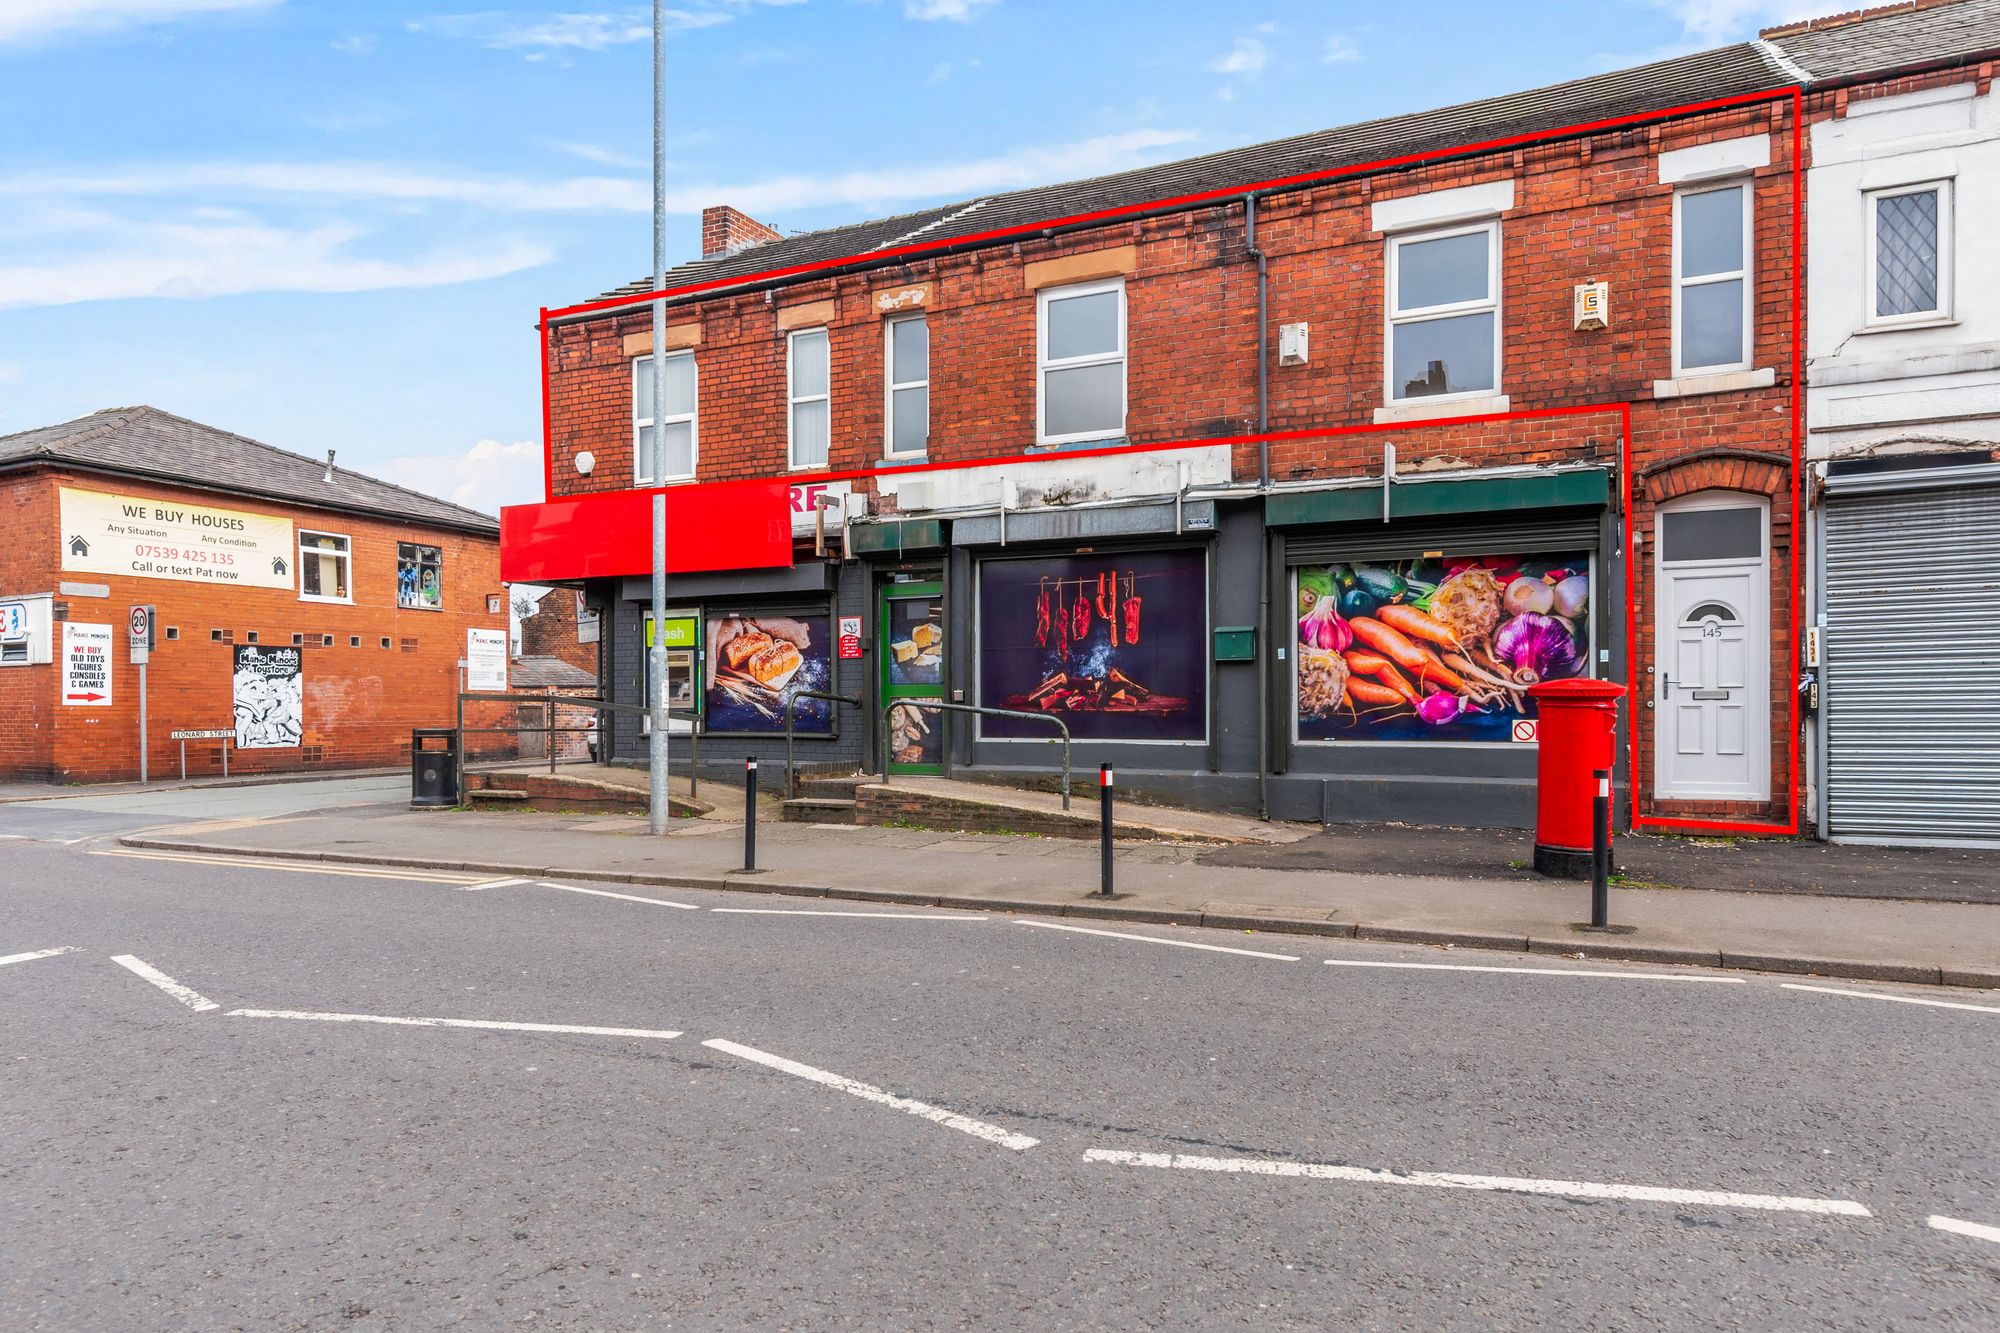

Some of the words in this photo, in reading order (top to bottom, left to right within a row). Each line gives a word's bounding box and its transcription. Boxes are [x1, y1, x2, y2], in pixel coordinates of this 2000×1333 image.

[122, 504, 146, 518] WE
[155, 509, 183, 523] BUY
[192, 513, 245, 531] HOUSES
[107, 524, 125, 535] Any
[127, 526, 168, 538] Situation
[201, 535, 216, 545] Any
[219, 536, 257, 548] Condition
[135, 544, 178, 560] 07539
[182, 549, 207, 563] 425
[211, 552, 234, 565] 135
[132, 561, 153, 573] Call
[156, 565, 168, 574] or
[171, 565, 193, 576] text
[196, 567, 213, 577] Pat
[216, 570, 239, 580] now
[133, 615, 145, 627] 20
[664, 626, 685, 640] ash
[1702, 628, 1722, 637] 145
[132, 637, 146, 645] ZONE
[73, 646, 85, 654] WE
[87, 646, 102, 655] BUY
[70, 654, 84, 662] OLD
[86, 655, 105, 663] TOYS
[240, 653, 267, 665] Manic
[267, 654, 299, 665] Minors
[73, 663, 103, 671] FIGURES
[251, 663, 290, 676] Toystore
[69, 671, 106, 680] CONSOLES
[71, 680, 77, 688] &
[78, 681, 104, 689] GAMES
[173, 731, 206, 739] LEONARD
[209, 730, 234, 738] STREET
